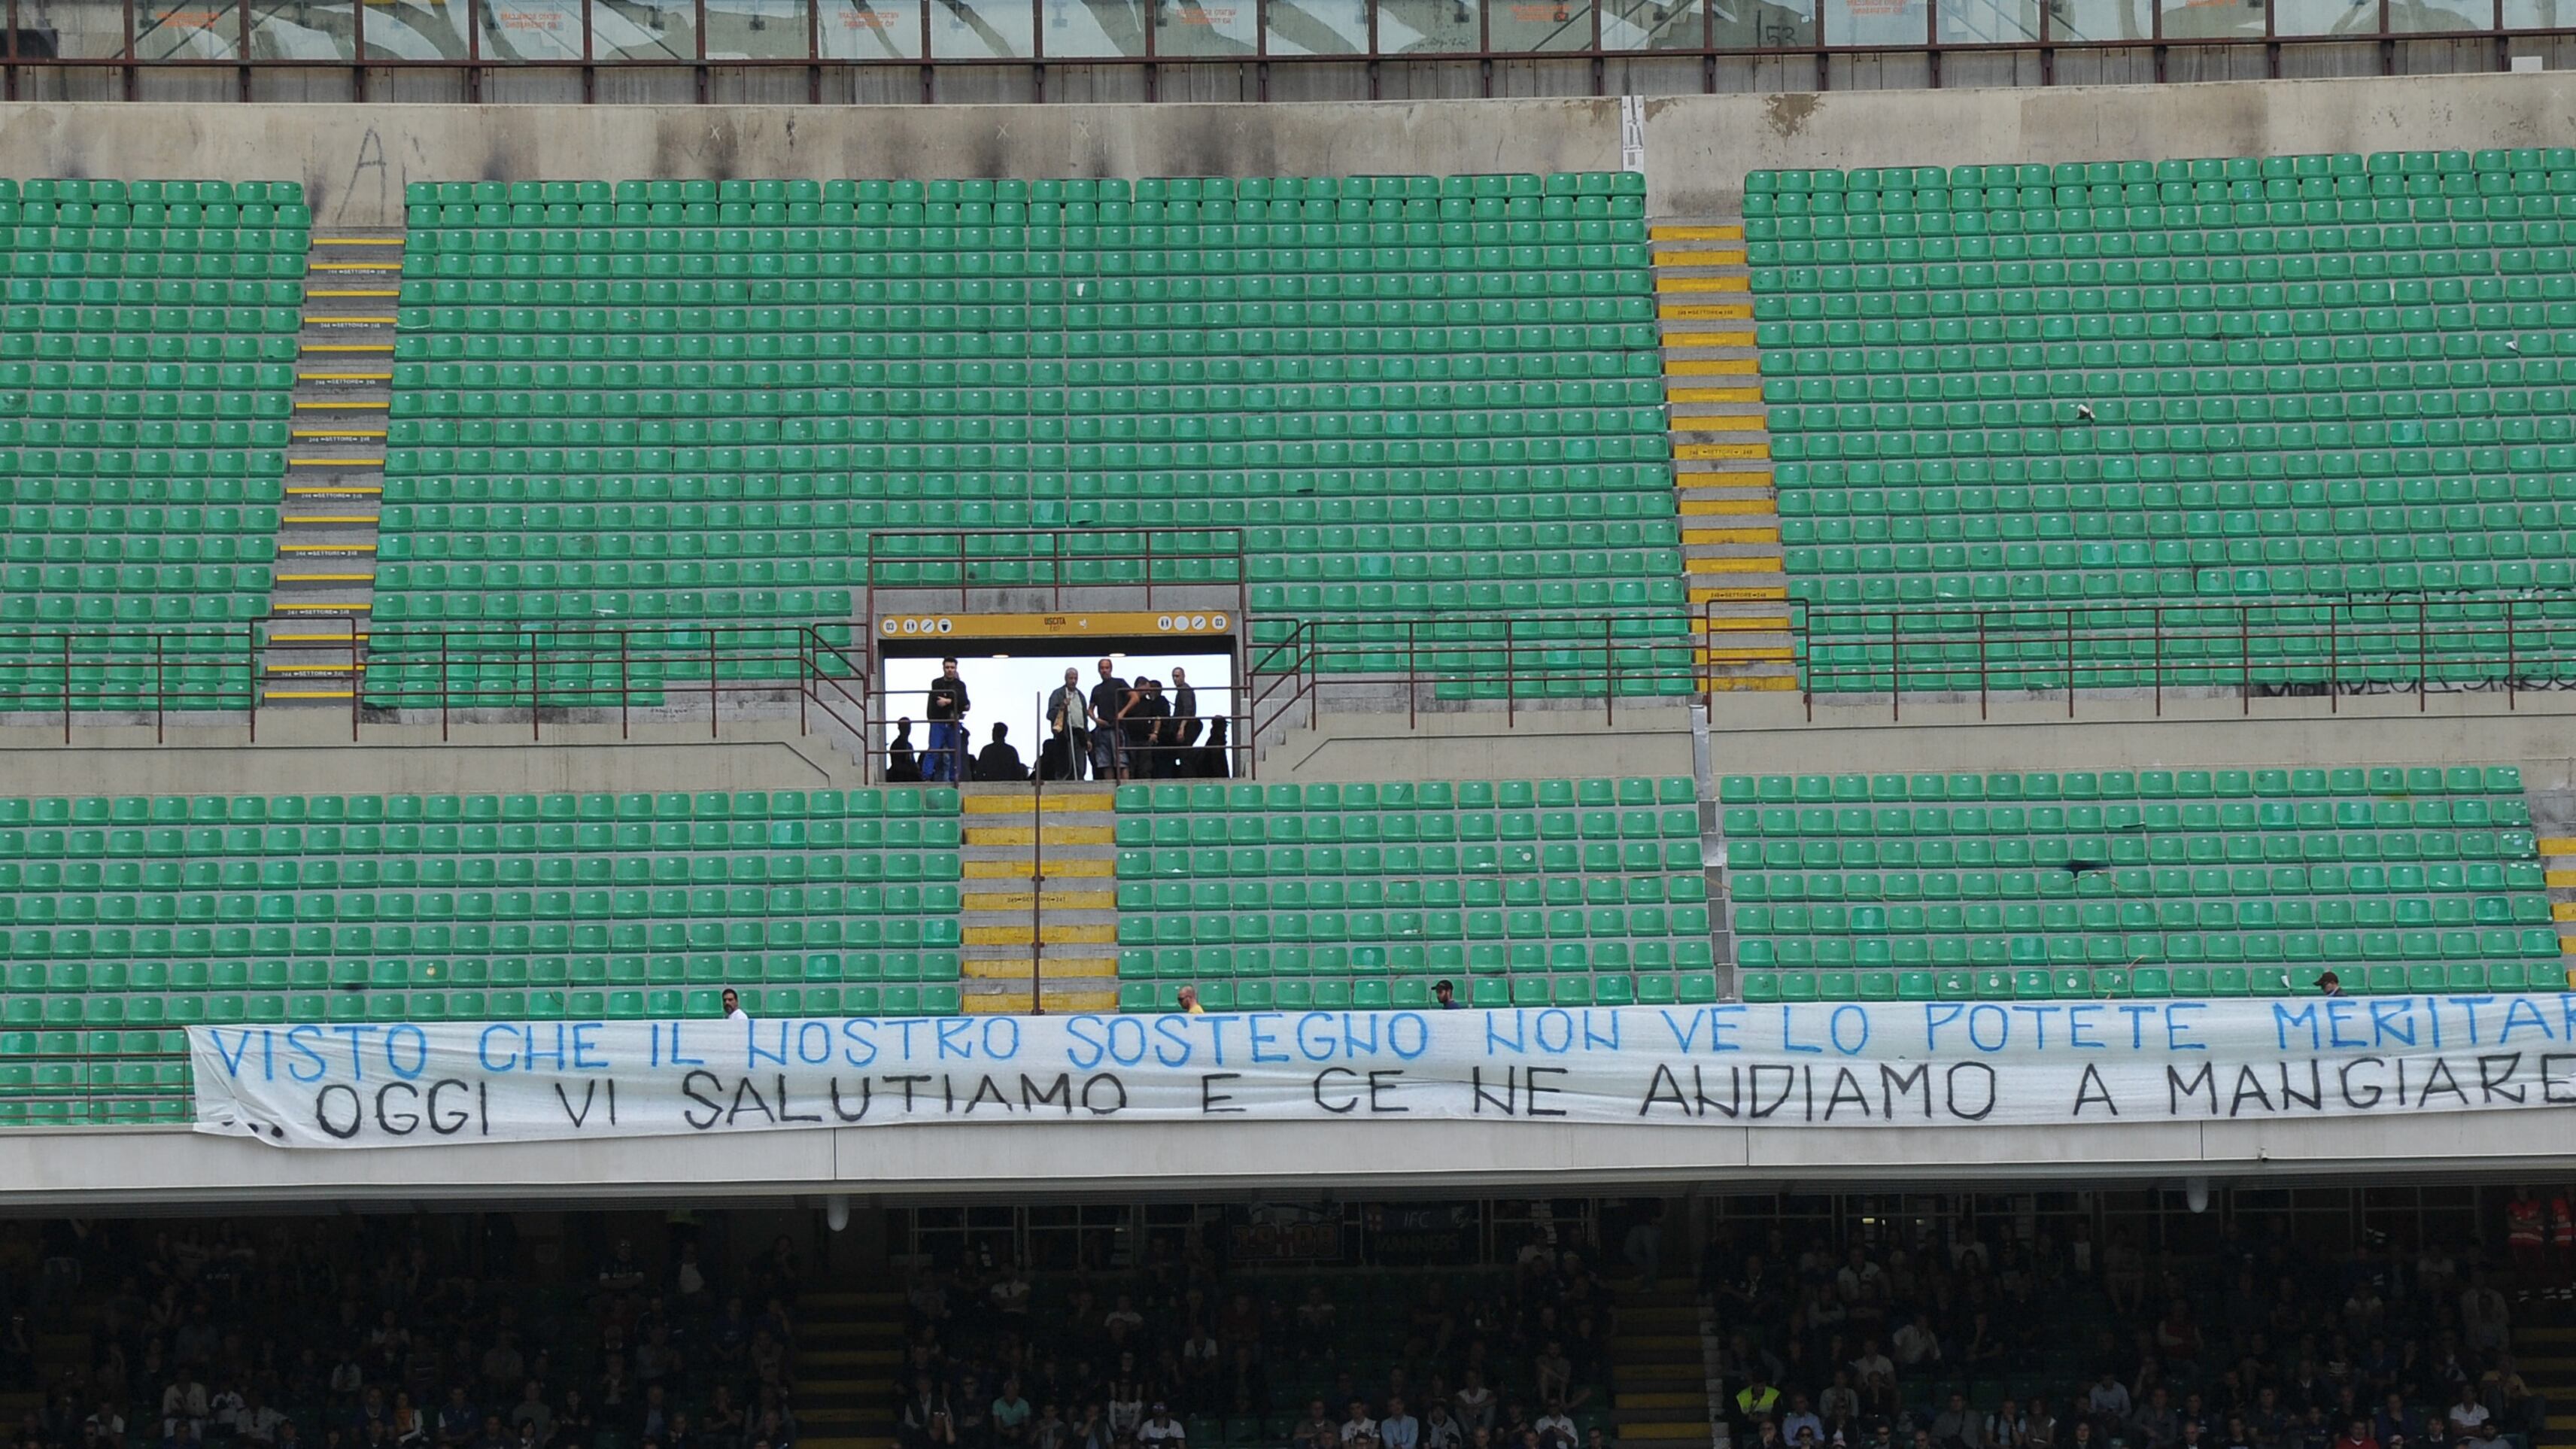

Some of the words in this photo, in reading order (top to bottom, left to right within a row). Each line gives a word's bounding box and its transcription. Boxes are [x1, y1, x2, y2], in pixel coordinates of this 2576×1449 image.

[211, 1023, 427, 1082] VISTO
[478, 1022, 609, 1072] CHE
[652, 1022, 705, 1067] IL
[748, 1016, 1019, 1069] NOSTRO
[1066, 1011, 1429, 1069] SOSTEGNO
[1485, 1005, 1619, 1056] NON
[1660, 1005, 1746, 1053] VE
[1783, 1004, 1869, 1055] LO
[1925, 1003, 2207, 1052] POTETE
[554, 1078, 615, 1129] VI
[682, 1069, 1128, 1129] SALUTIAMO
[1202, 1073, 1247, 1114] E
[1314, 1067, 1409, 1113] CE
[1472, 1065, 1568, 1116] NE
[1639, 1061, 1996, 1121] ANDIAMO
[2073, 1062, 2119, 1116] A
[2166, 1052, 2576, 1117] MANGIARE
